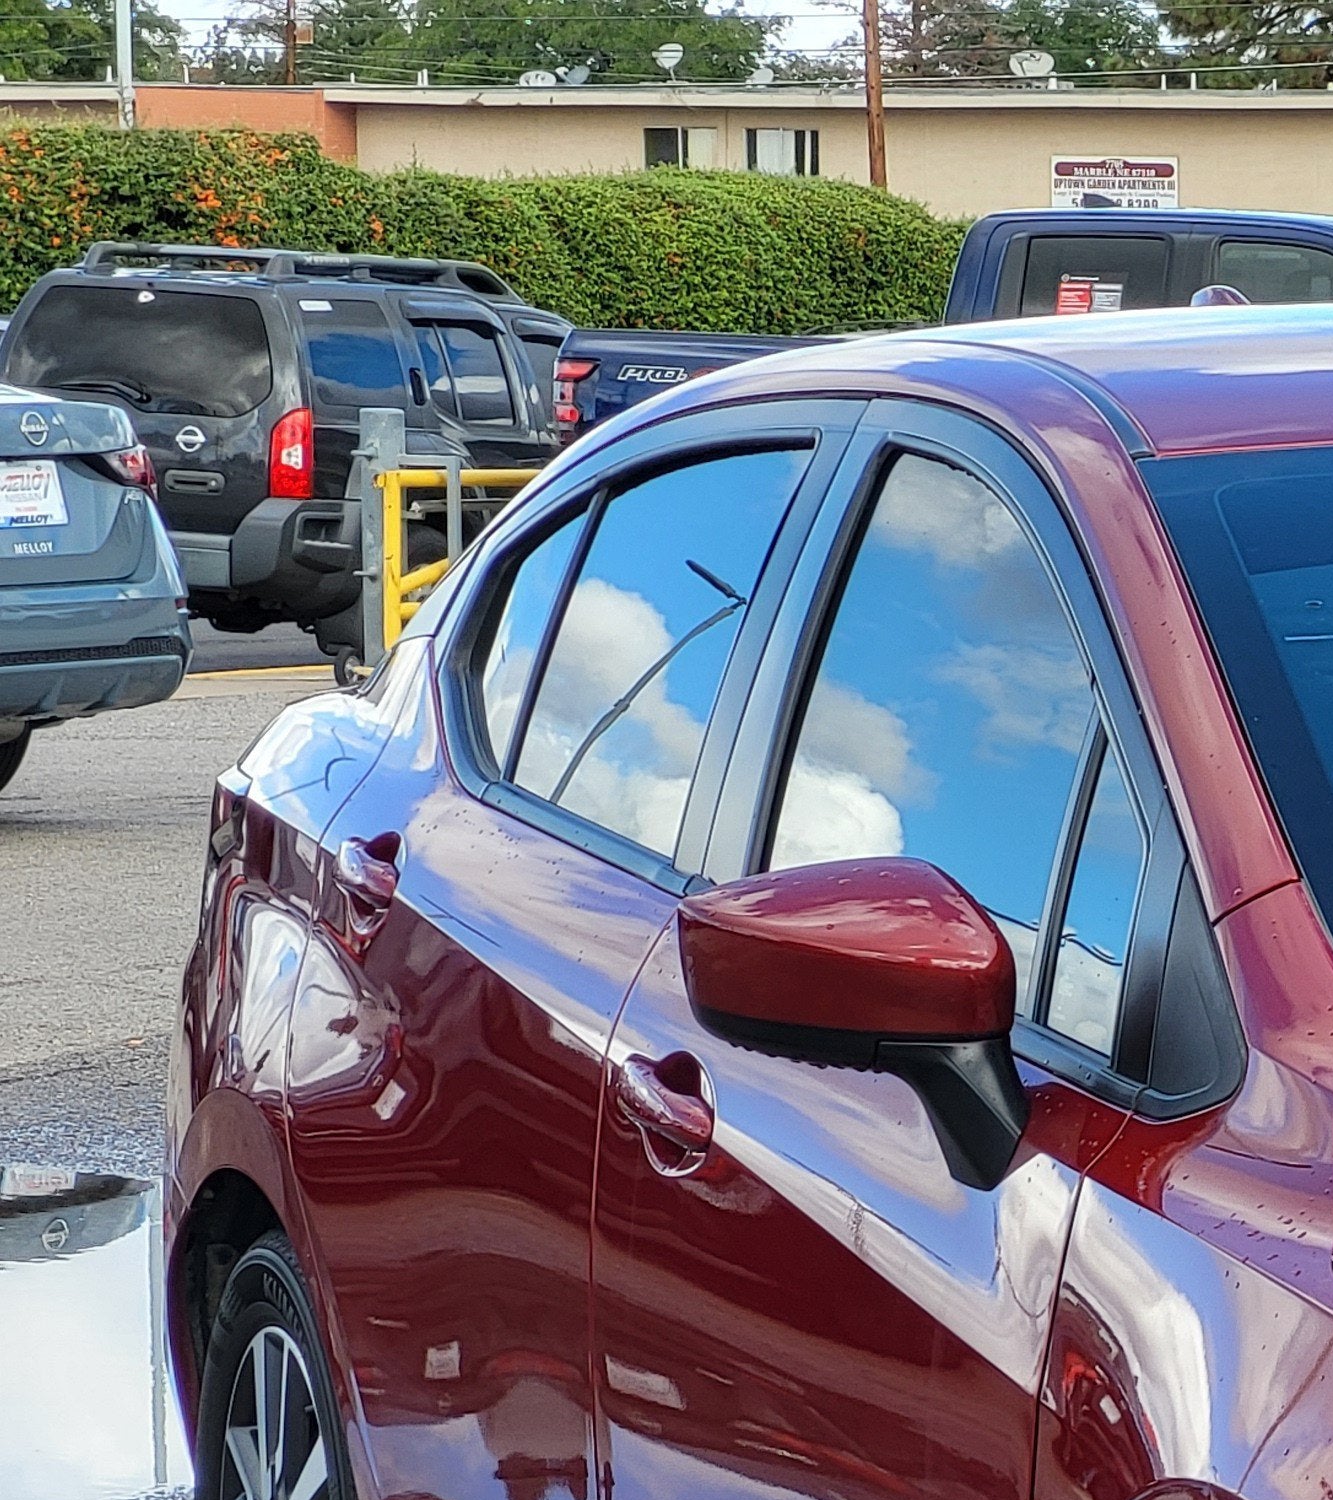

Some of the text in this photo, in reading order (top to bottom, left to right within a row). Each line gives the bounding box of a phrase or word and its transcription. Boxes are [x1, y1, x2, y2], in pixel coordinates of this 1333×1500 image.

[1073, 167, 1115, 177] MARBLE
[1054, 178, 1085, 188] UPTOWN
[1087, 179, 1116, 189] GARDEN
[1117, 179, 1165, 190] APARTMENTS
[13, 541, 53, 554] MELLOY
